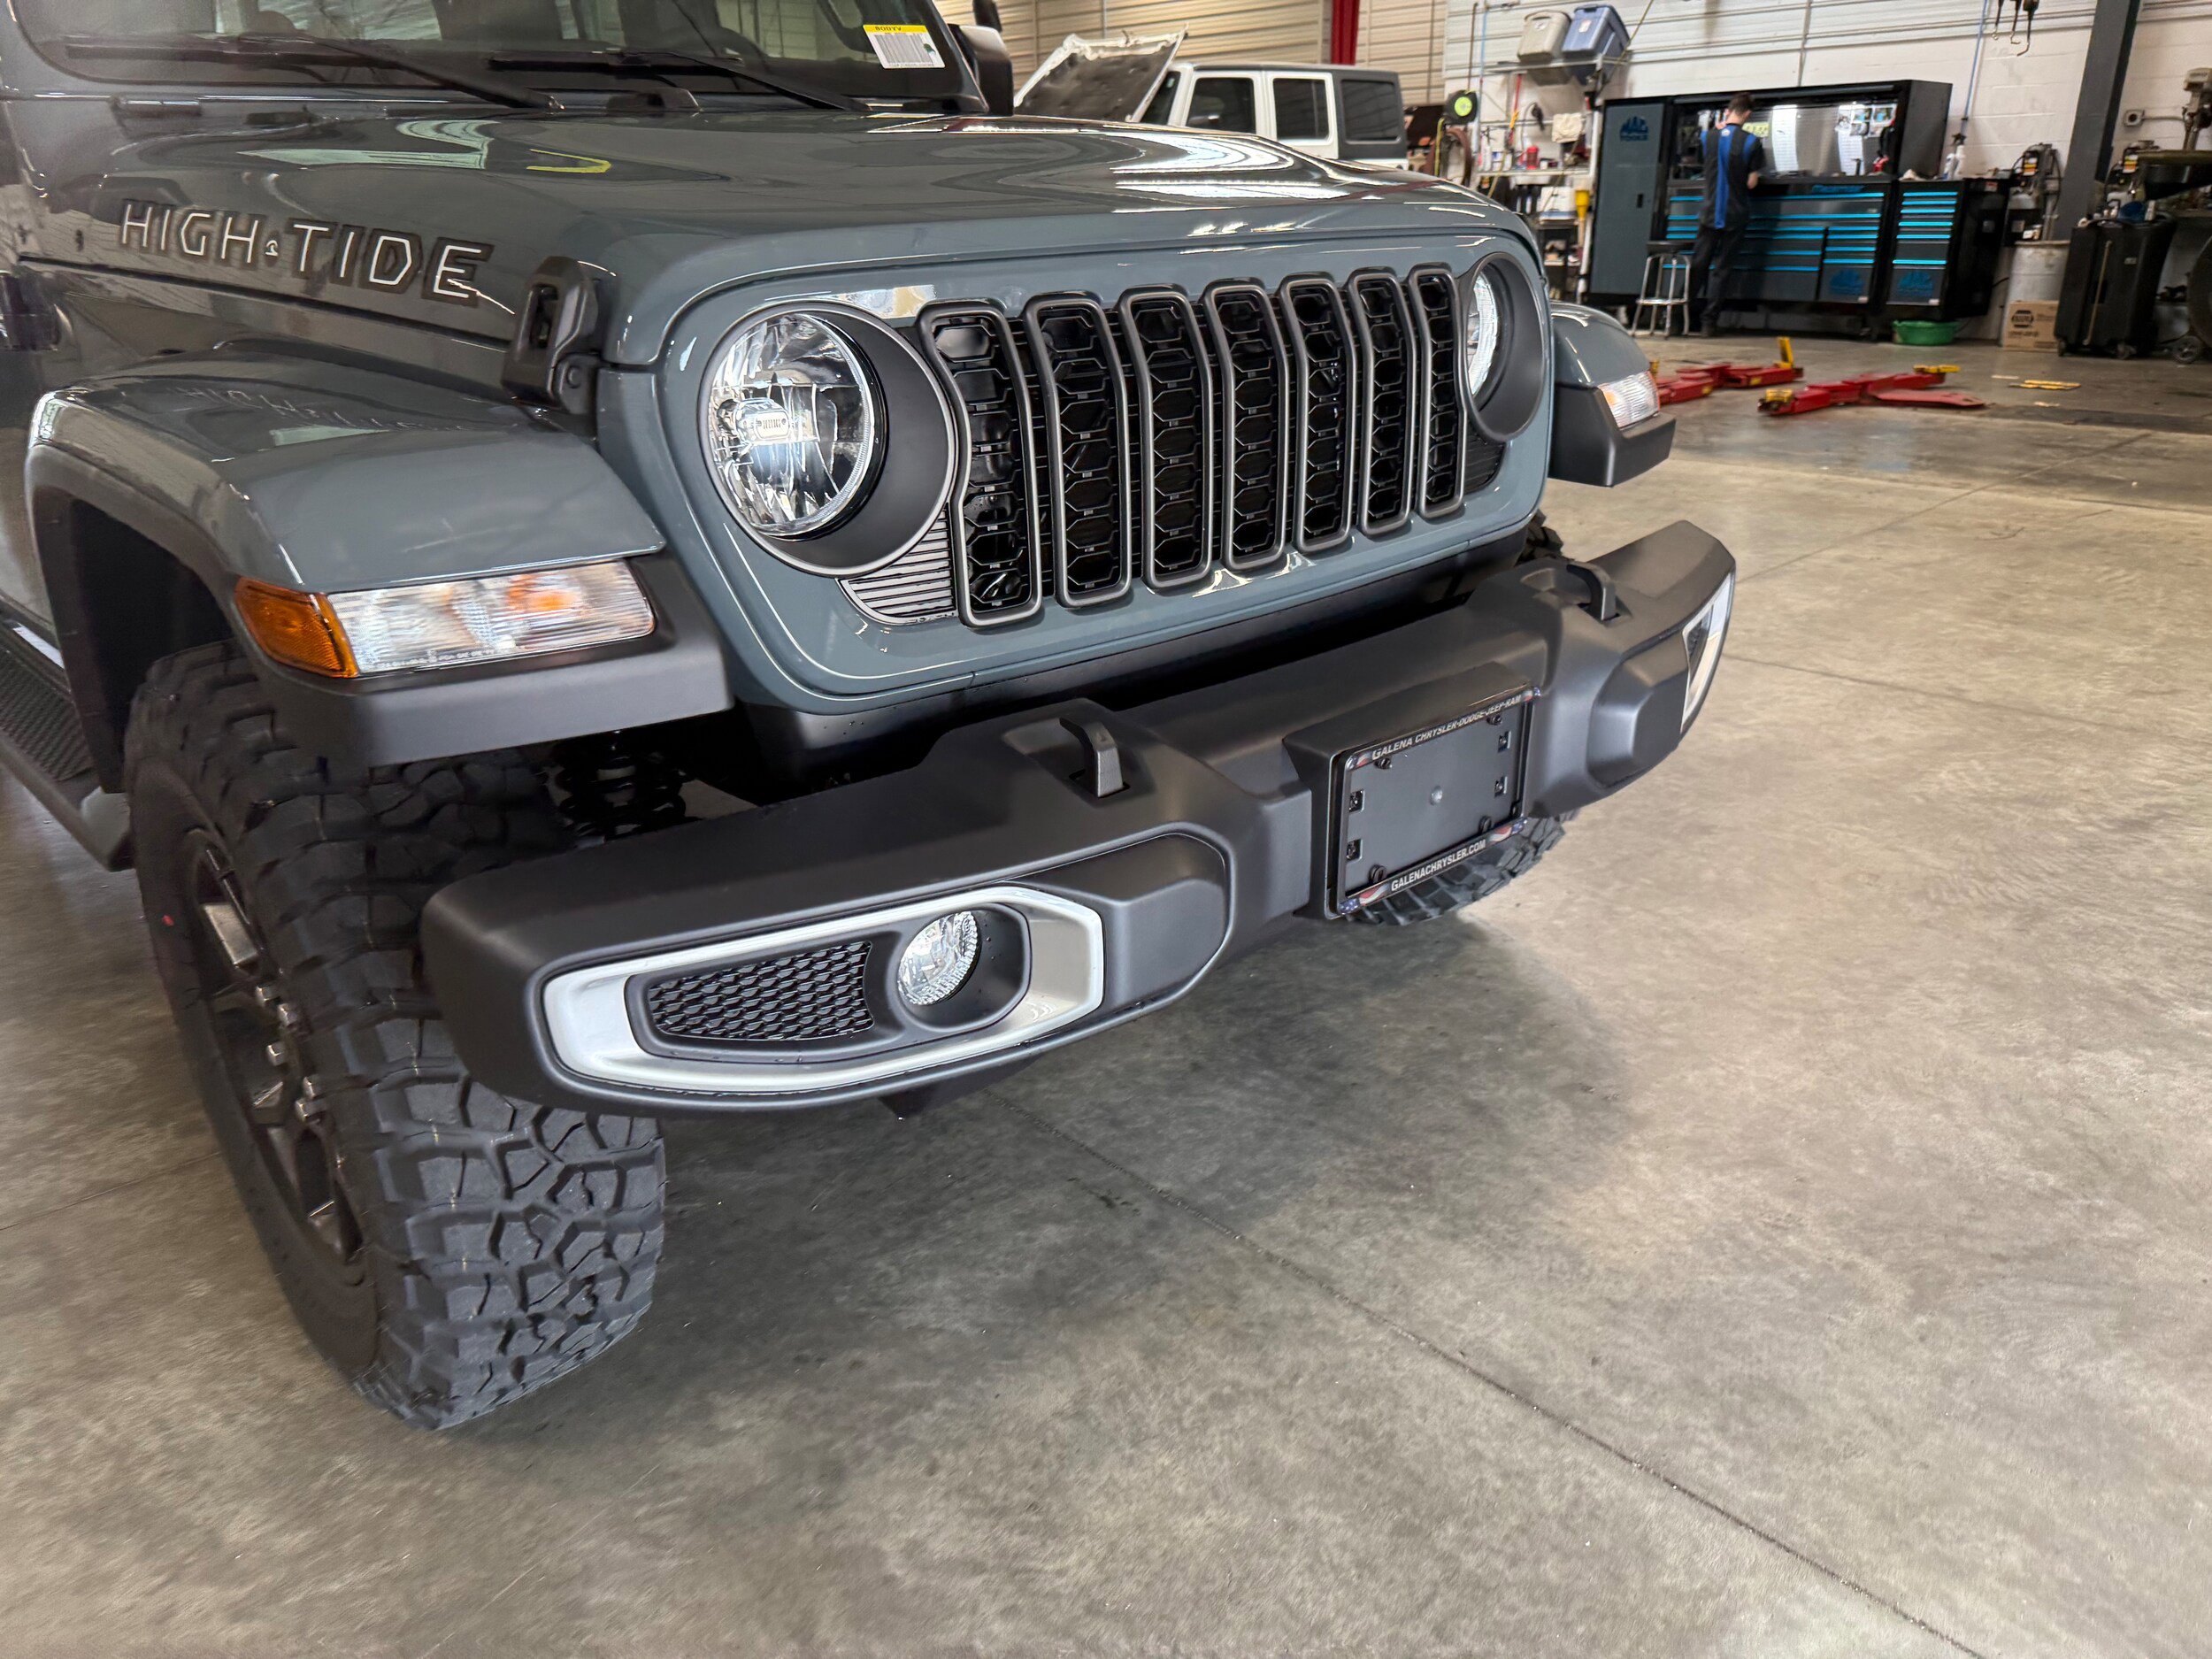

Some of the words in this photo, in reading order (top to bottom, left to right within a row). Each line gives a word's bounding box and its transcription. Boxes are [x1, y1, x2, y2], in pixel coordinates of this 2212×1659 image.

[119, 201, 263, 266] HIGH
[288, 219, 489, 303] TIDE
[1371, 736, 1413, 761] GALENA
[1391, 839, 1486, 892] GALENACHRYSLER.COM
